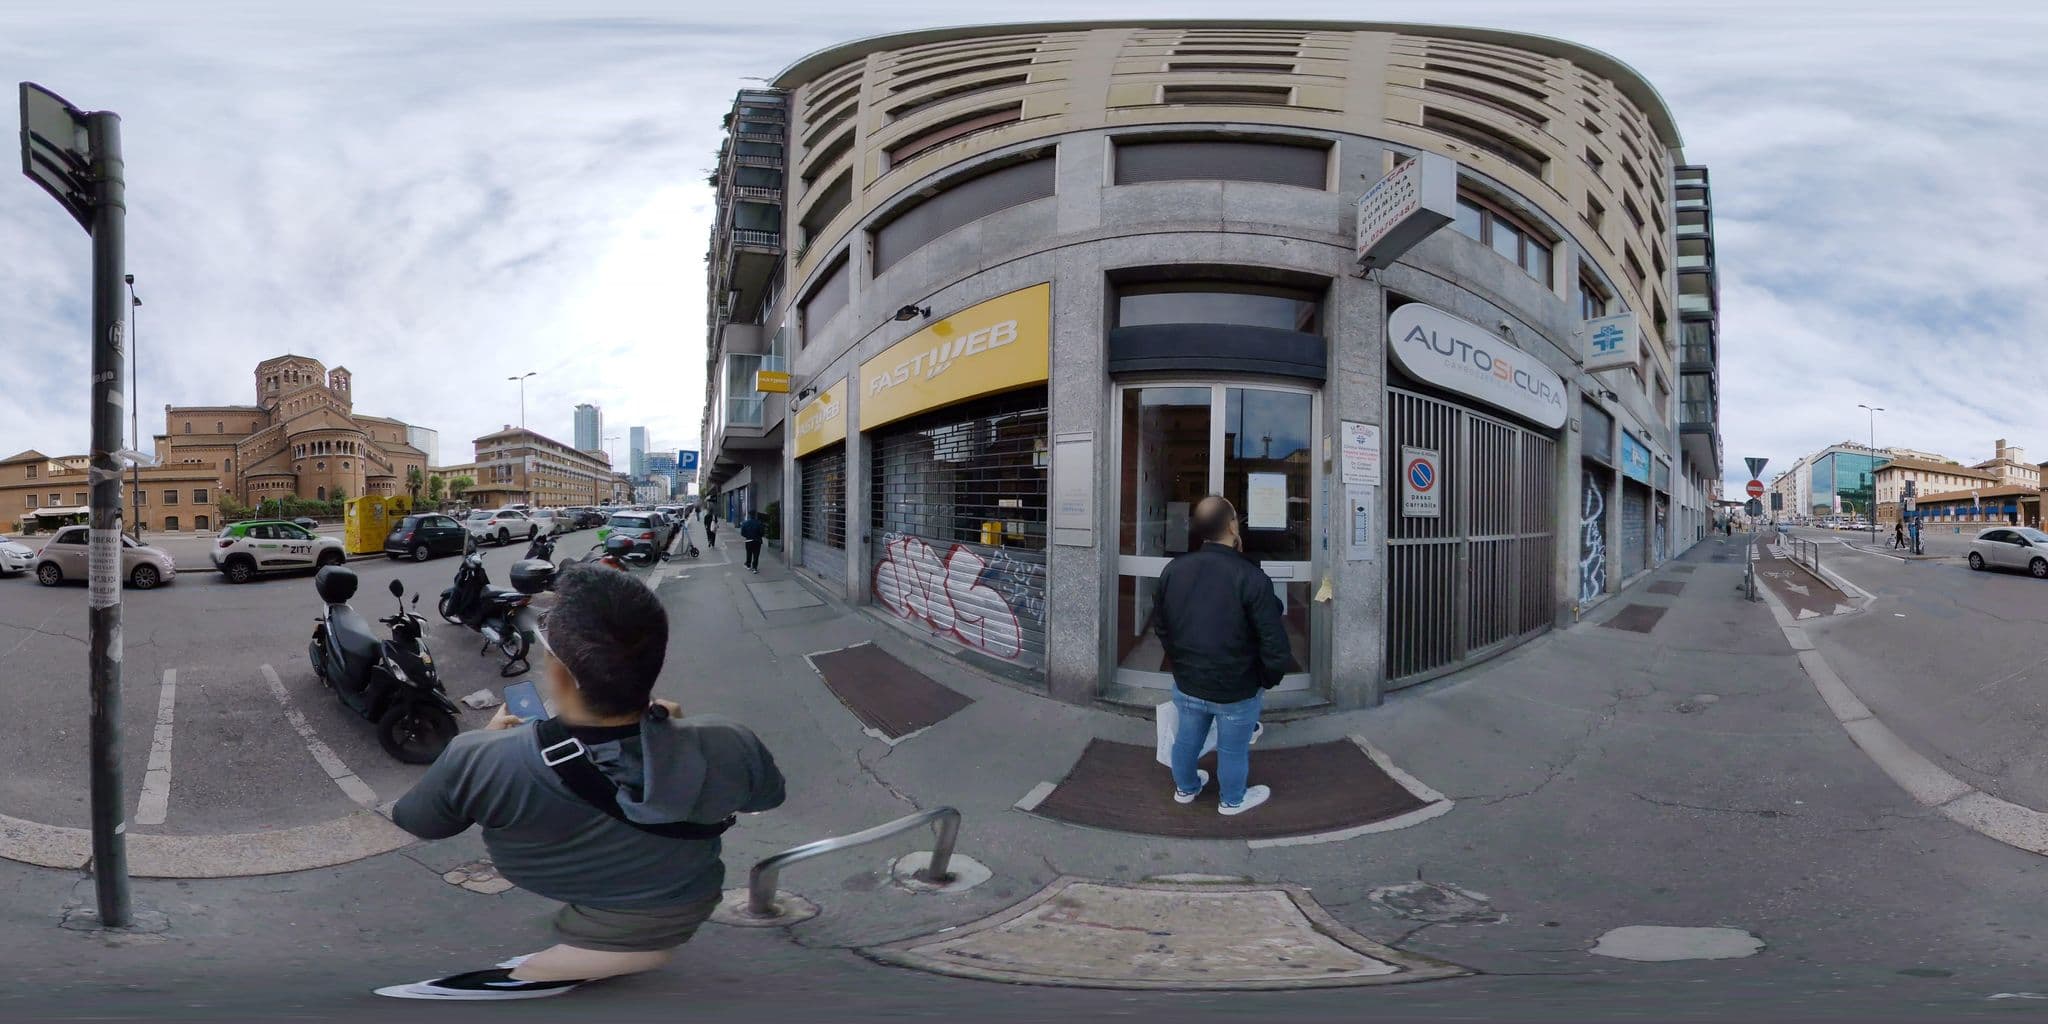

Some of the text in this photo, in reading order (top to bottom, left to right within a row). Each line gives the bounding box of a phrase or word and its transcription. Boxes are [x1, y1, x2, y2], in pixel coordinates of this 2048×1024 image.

[1362, 182, 1412, 225] GOMMISTA
[1364, 174, 1409, 212] OFFICINA
[869, 319, 1019, 396] FASTWEB
[1404, 324, 1562, 409] AUTOSICURA
[682, 453, 695, 467] P
[290, 545, 312, 554] ZITY
